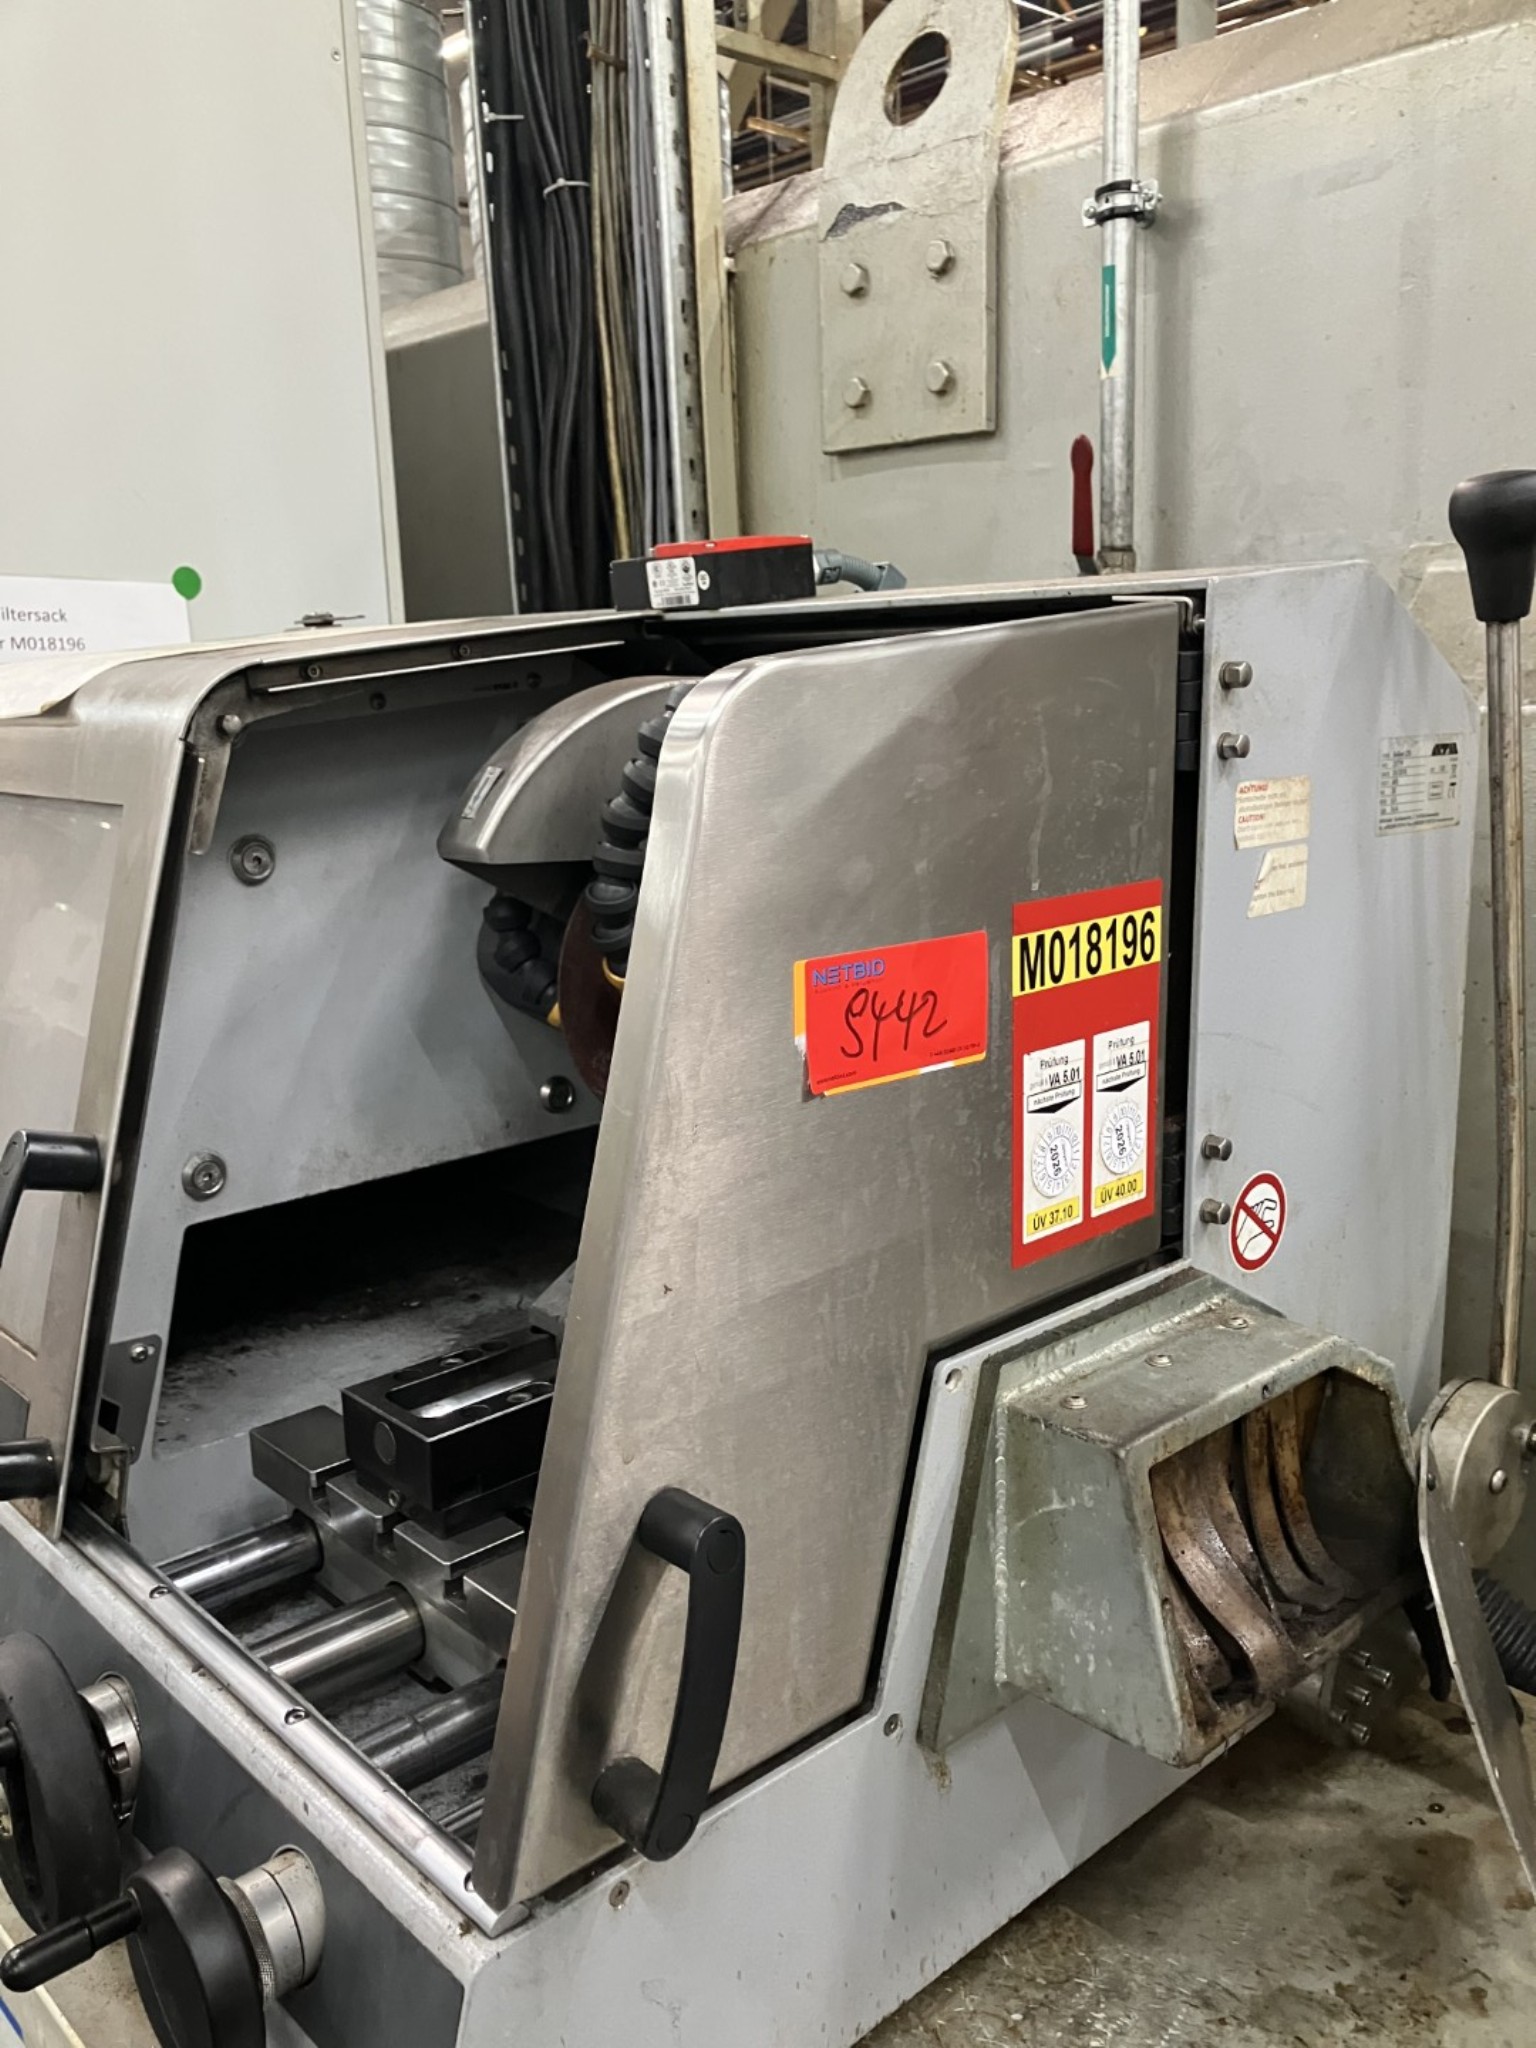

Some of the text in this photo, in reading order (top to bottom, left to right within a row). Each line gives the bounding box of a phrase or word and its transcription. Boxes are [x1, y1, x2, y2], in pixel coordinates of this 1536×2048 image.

[1, 606, 68, 623] iltersack
[10, 636, 86, 652] M018196
[1020, 911, 1155, 992] M018196
[812, 959, 886, 987] NETBID
[1040, 1056, 1069, 1070] Prüfung
[1116, 1054, 1127, 1068] VA
[1129, 1049, 1146, 1066] 5.01
[1049, 1072, 1061, 1087] VA
[1063, 1067, 1080, 1083] 5.01
[1049, 1205, 1074, 1225] 37.10
